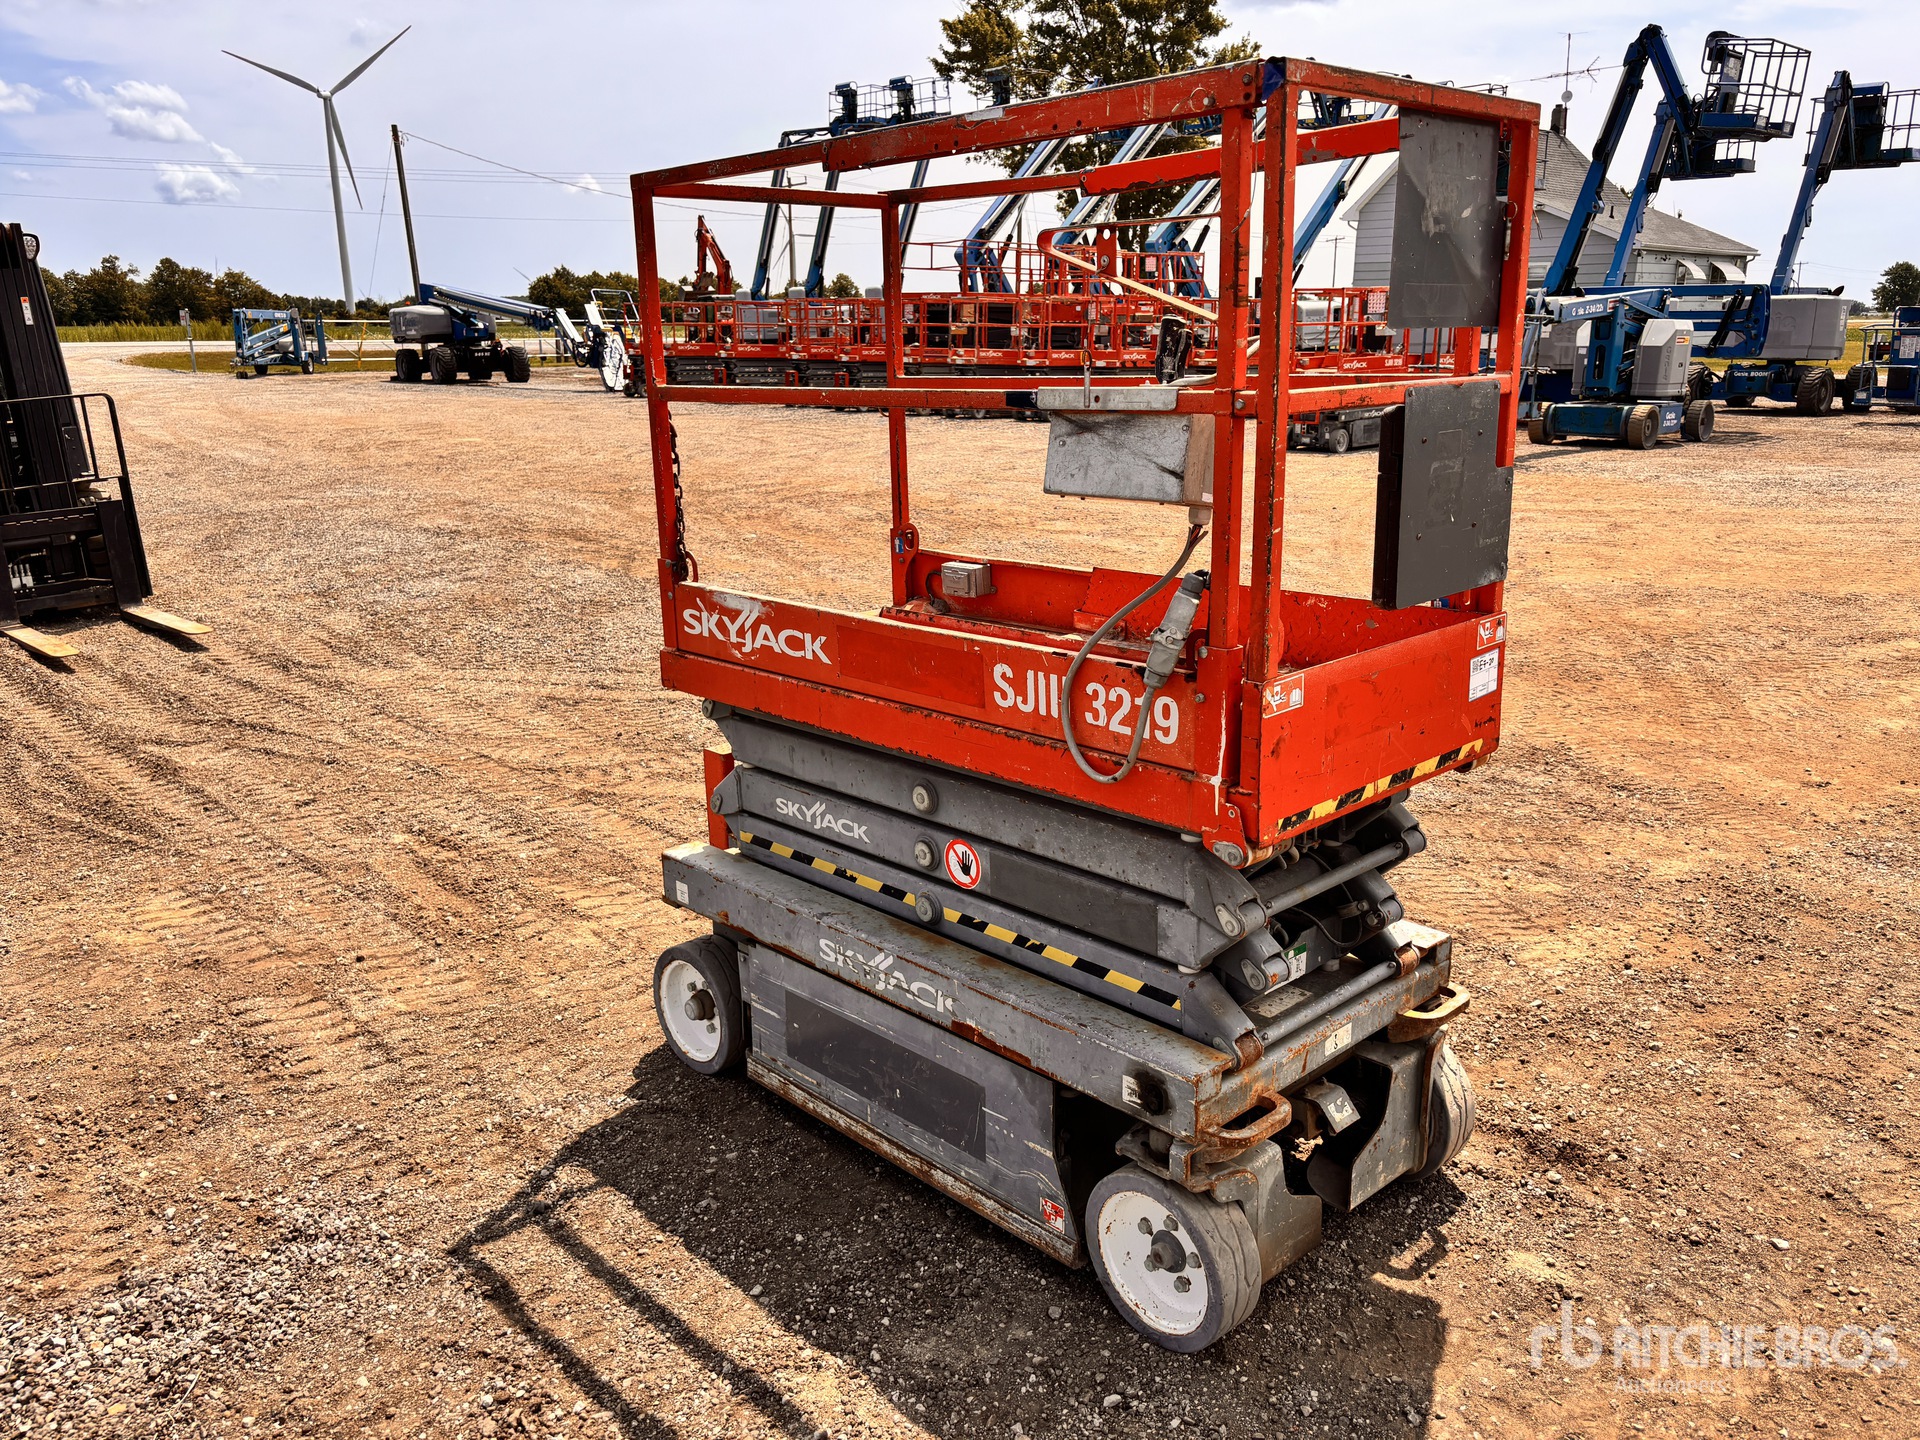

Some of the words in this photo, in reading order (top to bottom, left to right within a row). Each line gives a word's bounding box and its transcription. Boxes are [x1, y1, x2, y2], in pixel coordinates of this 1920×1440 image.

[1343, 360, 1368, 369] SKYJACK
[682, 603, 832, 665] SKYJACK
[775, 797, 871, 844] SKYJACK
